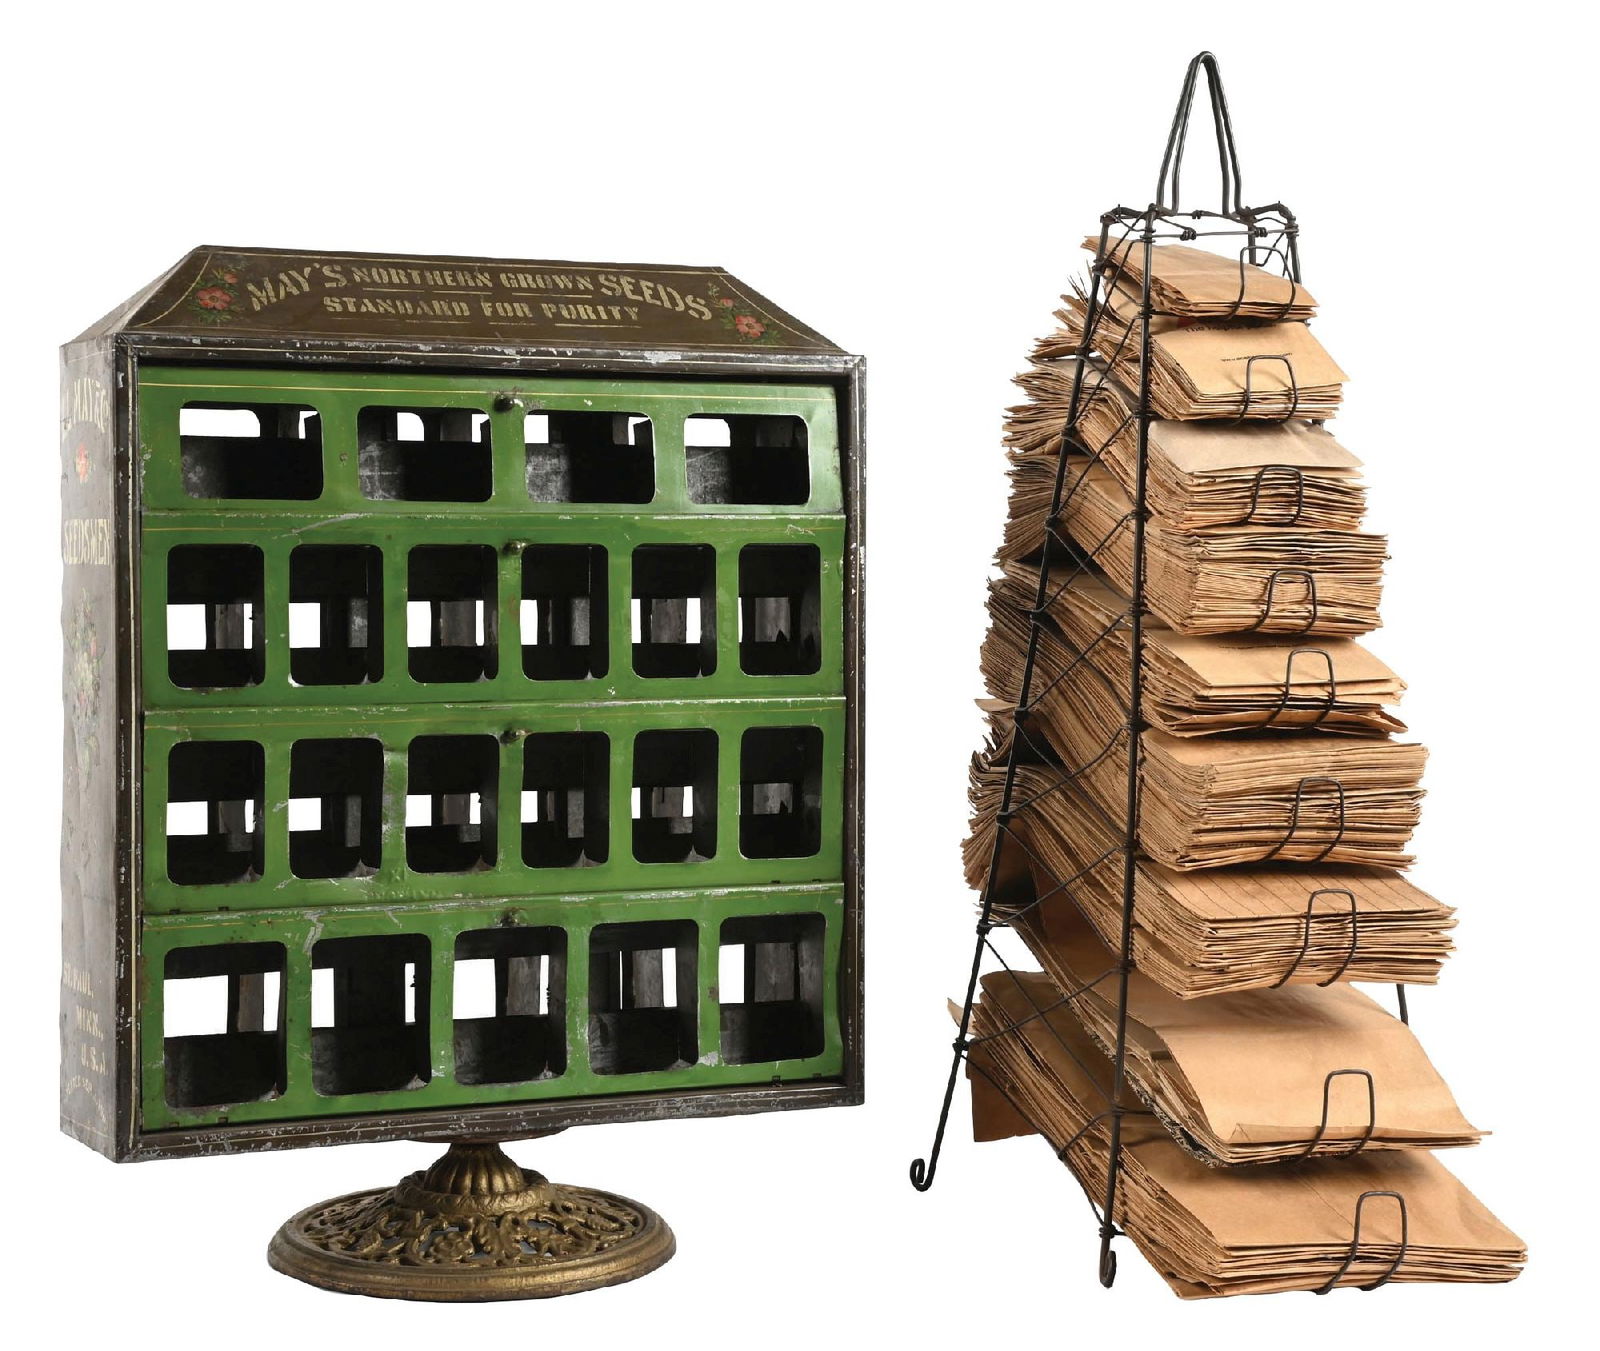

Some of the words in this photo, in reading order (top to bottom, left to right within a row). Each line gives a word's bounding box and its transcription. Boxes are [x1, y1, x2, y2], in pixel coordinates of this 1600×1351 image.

[246, 262, 348, 312] MAY'S
[351, 266, 493, 288] NORTHERN
[499, 272, 594, 291] GROWN
[598, 273, 713, 321] SEEDS
[322, 296, 471, 317] STANDARD
[480, 301, 533, 318] FOR
[541, 302, 640, 321] PURITY
[64, 518, 110, 566] SEEDSMEN
